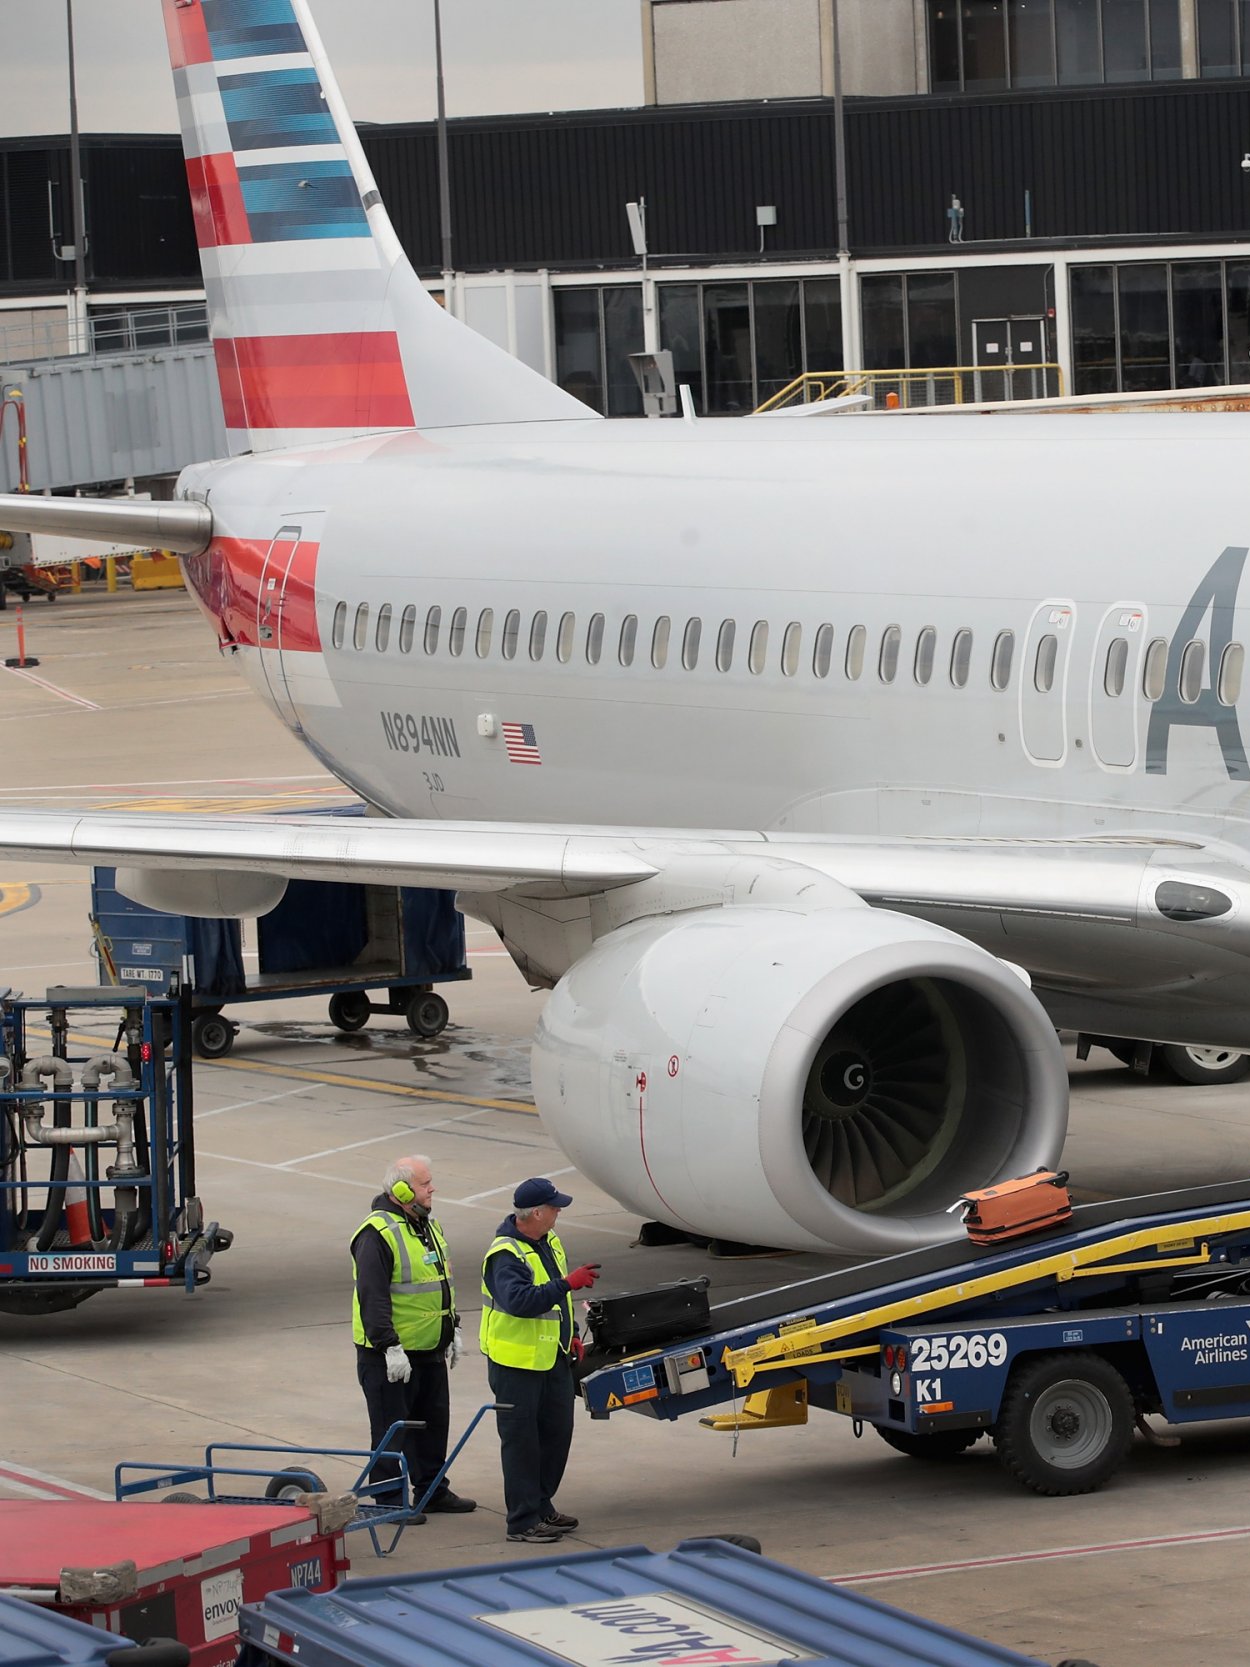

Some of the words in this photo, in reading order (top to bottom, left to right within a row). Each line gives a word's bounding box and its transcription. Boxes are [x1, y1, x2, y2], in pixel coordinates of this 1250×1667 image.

[380, 711, 461, 758] N894NN
[122, 968, 135, 978] TARE
[148, 969, 162, 980] 1770
[30, 1257, 49, 1271] NO
[53, 1256, 115, 1271] SMOKING
[911, 1333, 1008, 1372] 25269
[1181, 1333, 1247, 1351] American
[1194, 1348, 1248, 1365] Airlines
[916, 1378, 942, 1402] K1
[291, 1559, 321, 1588] NP744
[204, 1597, 241, 1620] envoy
